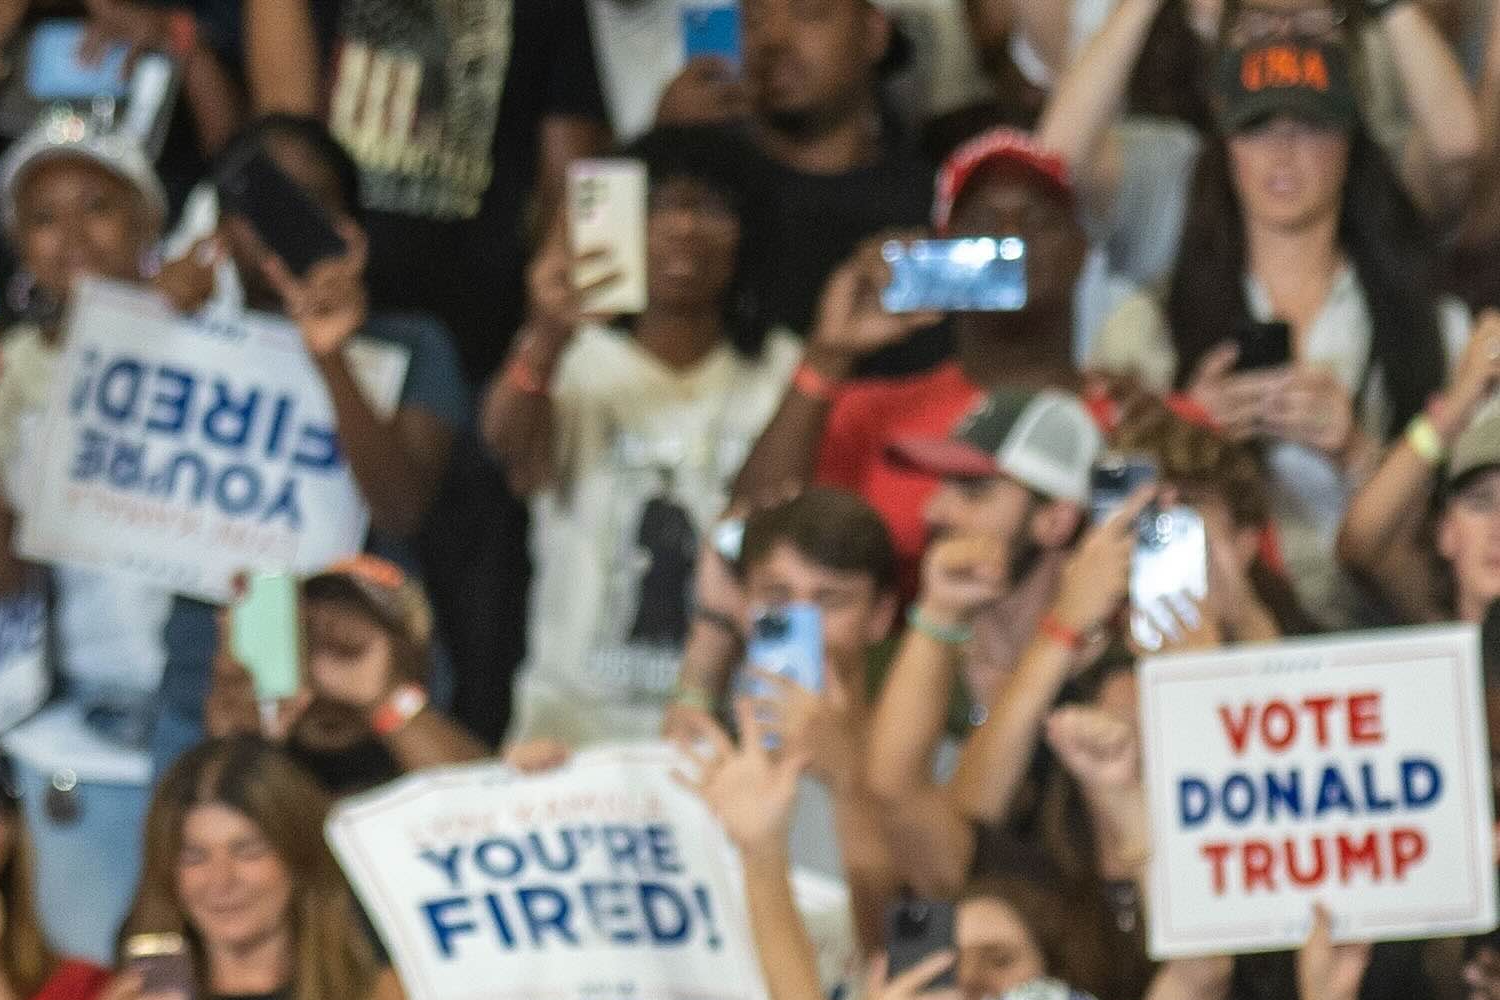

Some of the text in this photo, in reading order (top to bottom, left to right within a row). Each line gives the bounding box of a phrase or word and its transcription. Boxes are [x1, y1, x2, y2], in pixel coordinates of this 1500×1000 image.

[1219, 690, 1385, 756] VOTE
[1177, 756, 1444, 829] DONALD
[415, 820, 684, 886] YOU'RE
[1200, 829, 1427, 898] TRUMP
[420, 878, 723, 959] FIRED!
